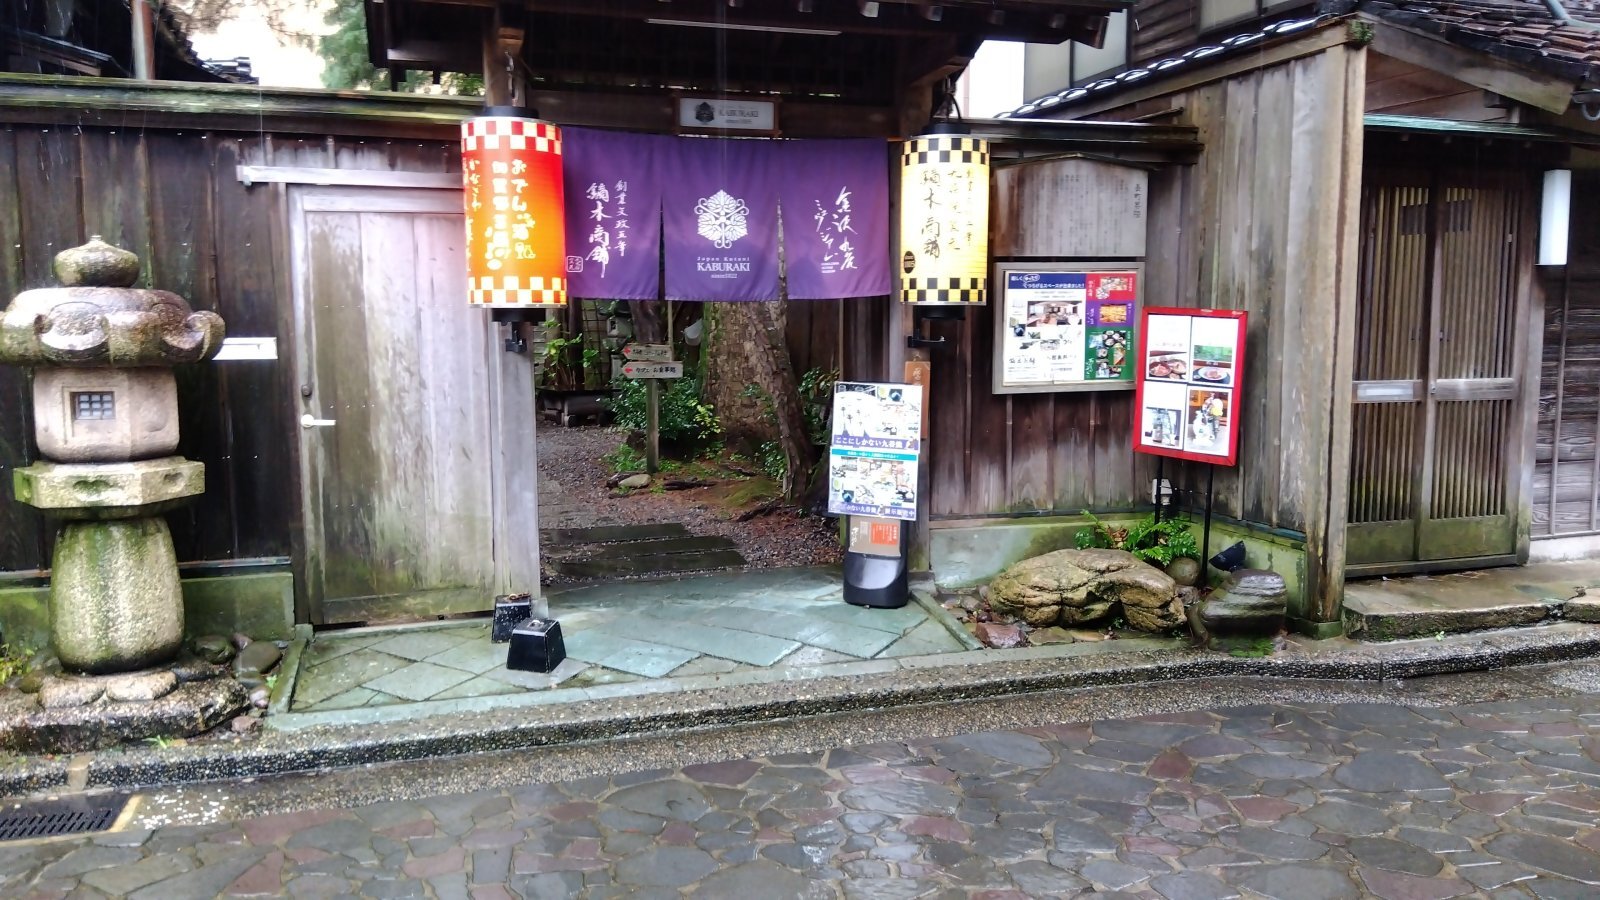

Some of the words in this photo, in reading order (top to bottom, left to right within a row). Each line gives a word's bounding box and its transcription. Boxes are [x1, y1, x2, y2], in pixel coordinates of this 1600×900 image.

[585, 183, 612, 278] 鏑木商舗
[614, 180, 630, 257] 創業文政五年
[696, 262, 751, 272] KABURAKI
